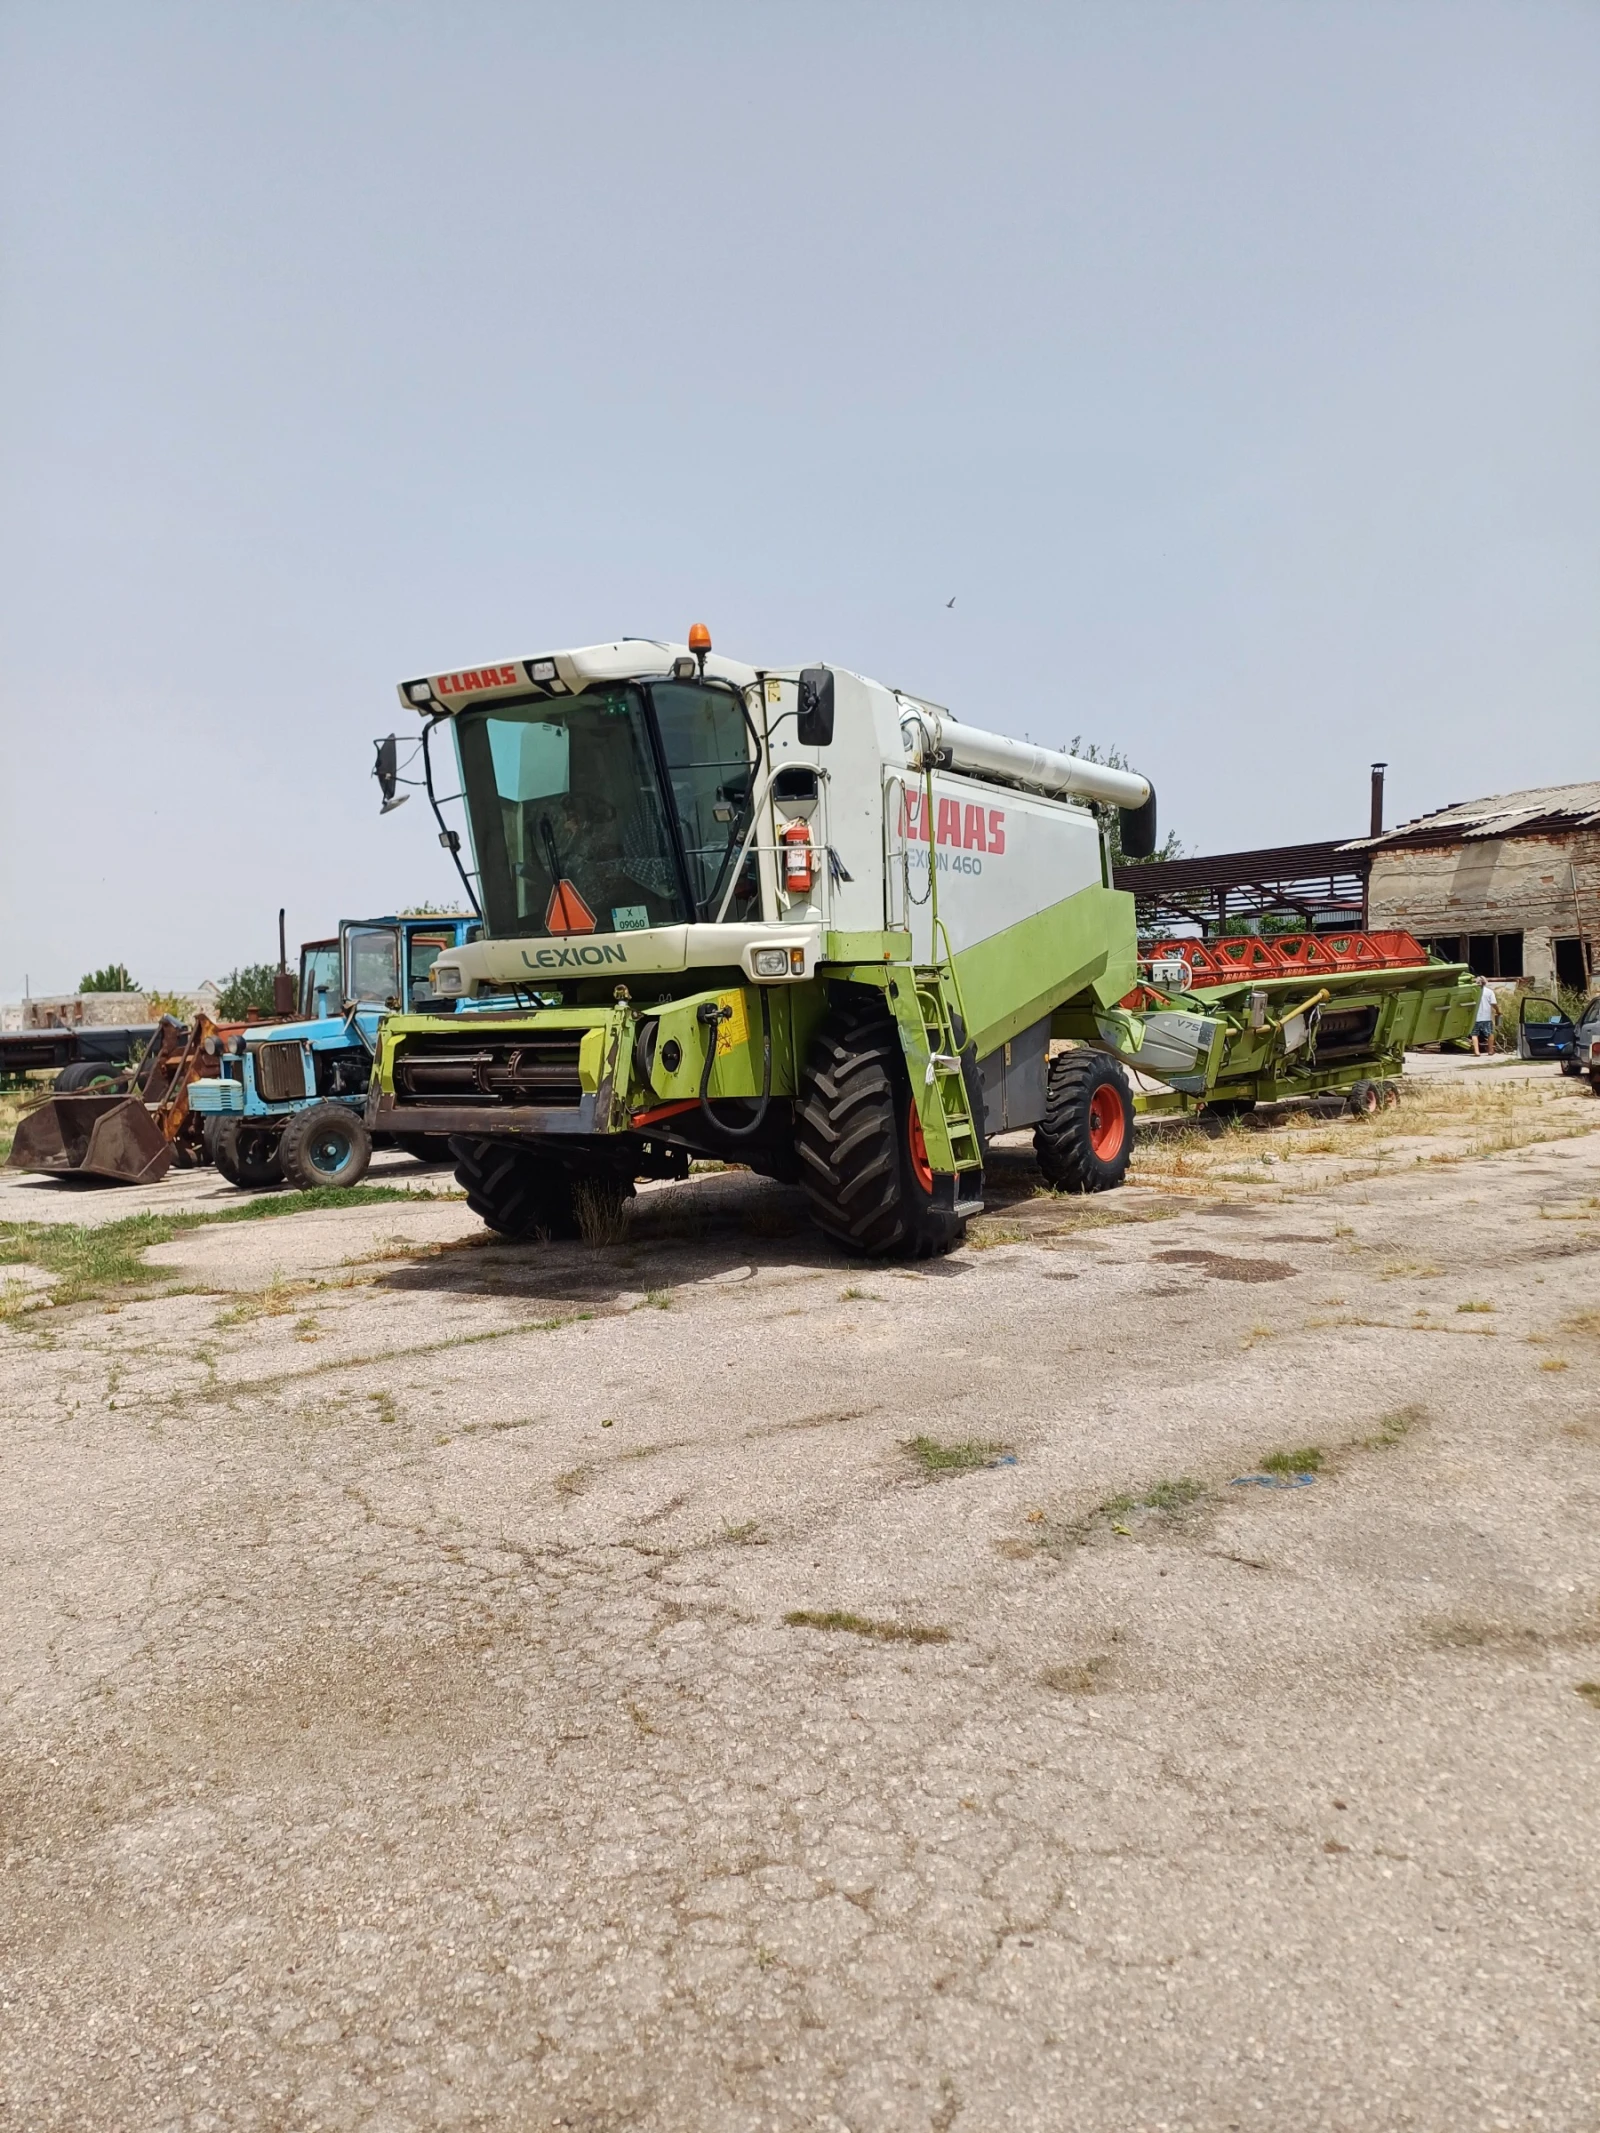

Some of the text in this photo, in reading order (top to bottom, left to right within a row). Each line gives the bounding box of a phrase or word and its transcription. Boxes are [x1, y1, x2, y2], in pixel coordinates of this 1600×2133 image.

[437, 664, 517, 695] CLAAS
[898, 789, 1005, 855] CLAAS
[952, 855, 982, 876] 460
[626, 908, 633, 917] X
[619, 919, 645, 930] 09060
[521, 943, 628, 969] LEXION
